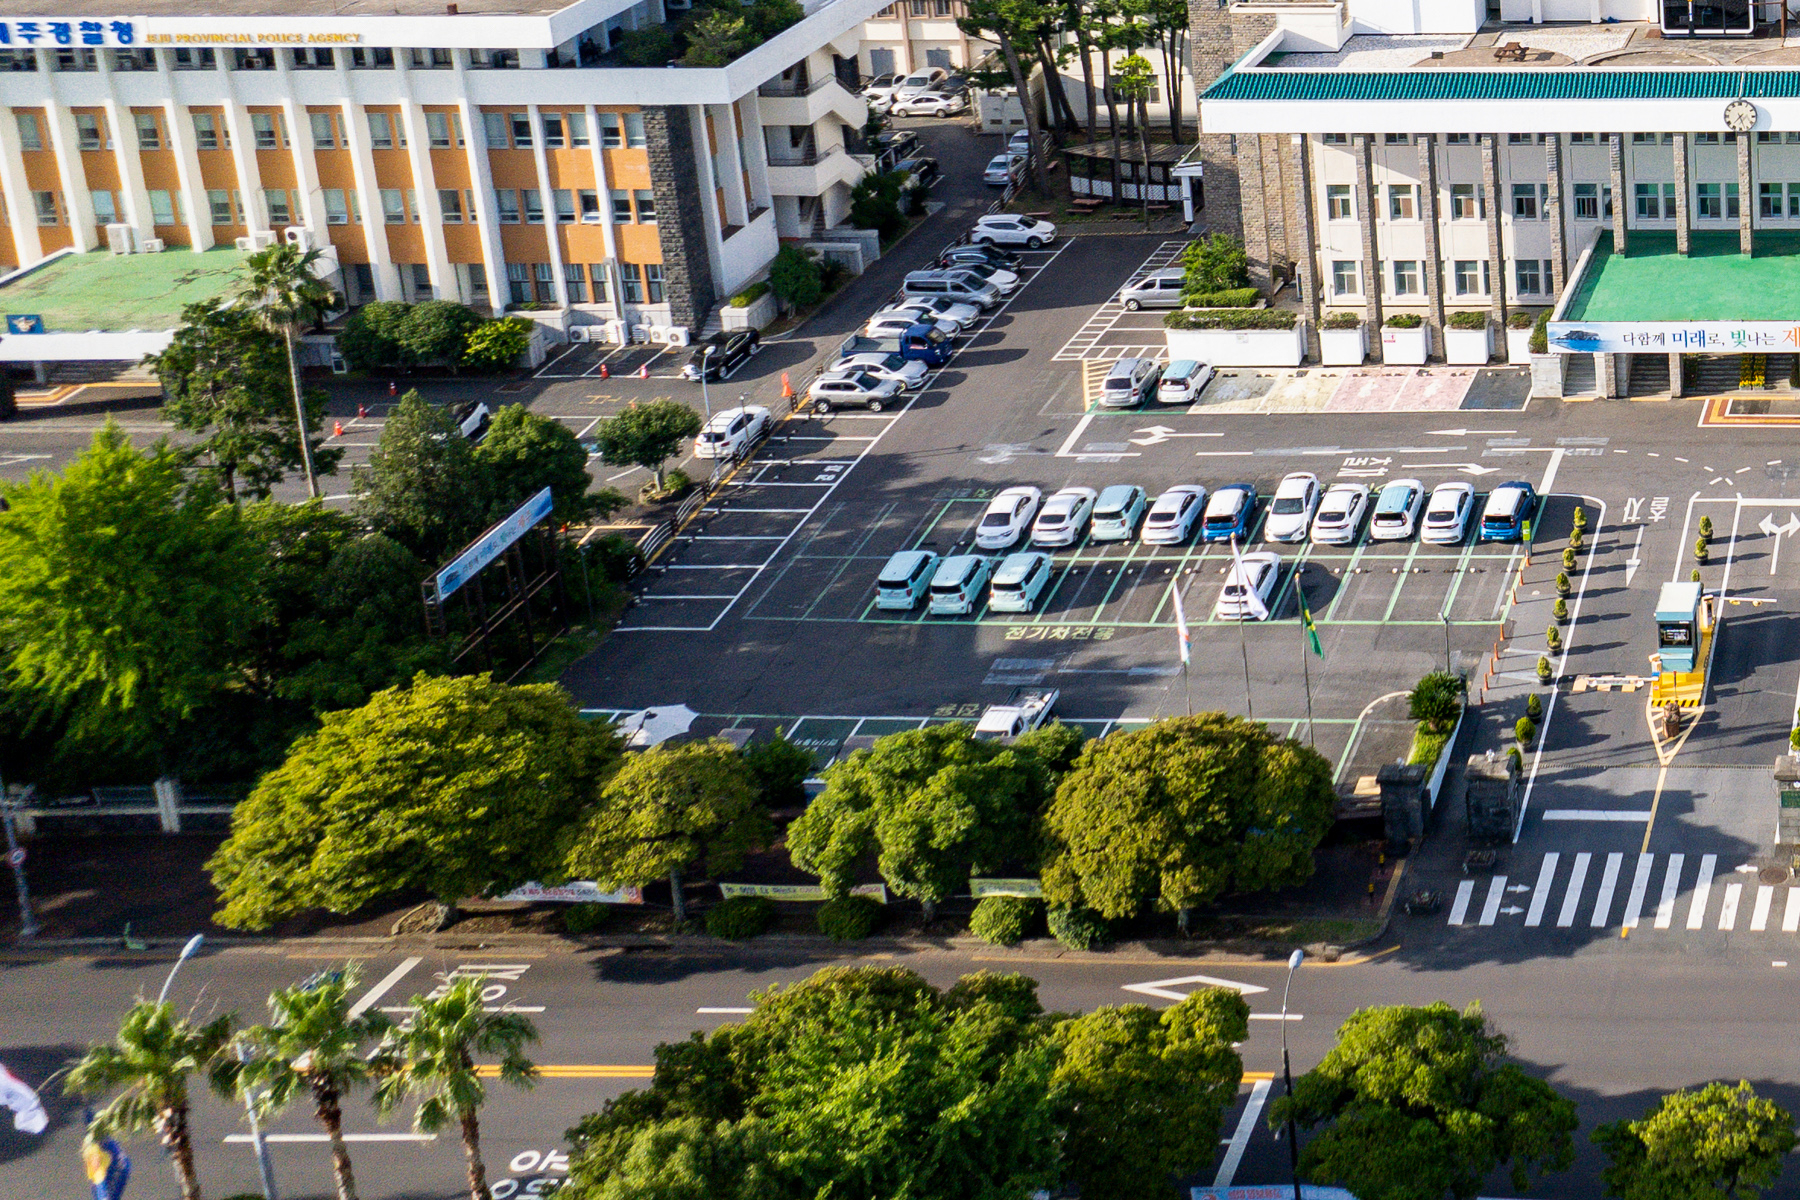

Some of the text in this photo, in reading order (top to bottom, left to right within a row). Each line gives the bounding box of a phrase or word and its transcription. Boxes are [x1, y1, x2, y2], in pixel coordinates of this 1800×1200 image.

[145, 33, 361, 44] JEJU PROVINCIAL POLICE AGENCY
[1622, 332, 1666, 347] 다함께
[1671, 329, 1725, 348] 미래로,
[1730, 329, 1776, 348] 빛나는
[1004, 626, 1115, 640] 전기차전용
